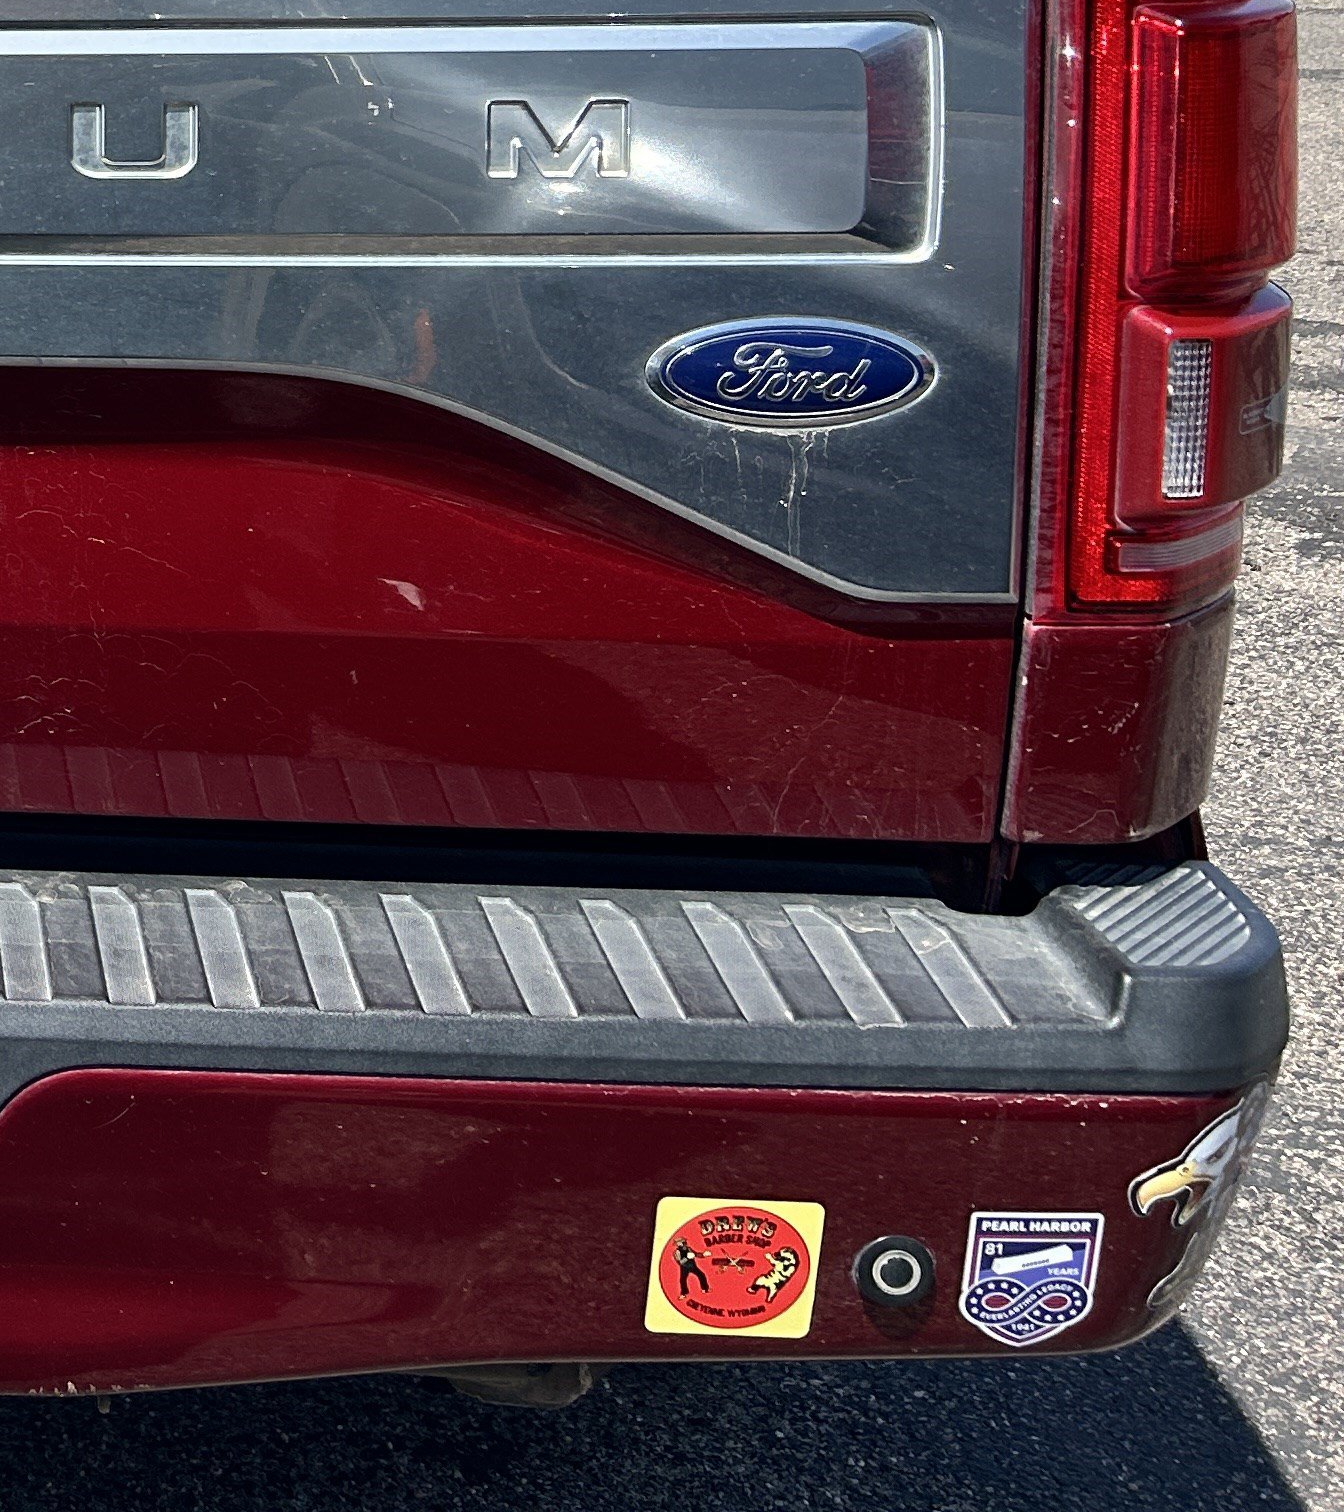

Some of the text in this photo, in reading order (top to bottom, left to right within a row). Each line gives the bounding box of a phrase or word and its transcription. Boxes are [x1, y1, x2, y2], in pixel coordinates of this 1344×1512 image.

[716, 341, 872, 403] Ford
[981, 1220, 1092, 1233] PEARL HARBOR
[703, 1233, 772, 1249] BARBER SHOP
[984, 1242, 1004, 1256] 81
[1047, 1267, 1080, 1276] YEARS
